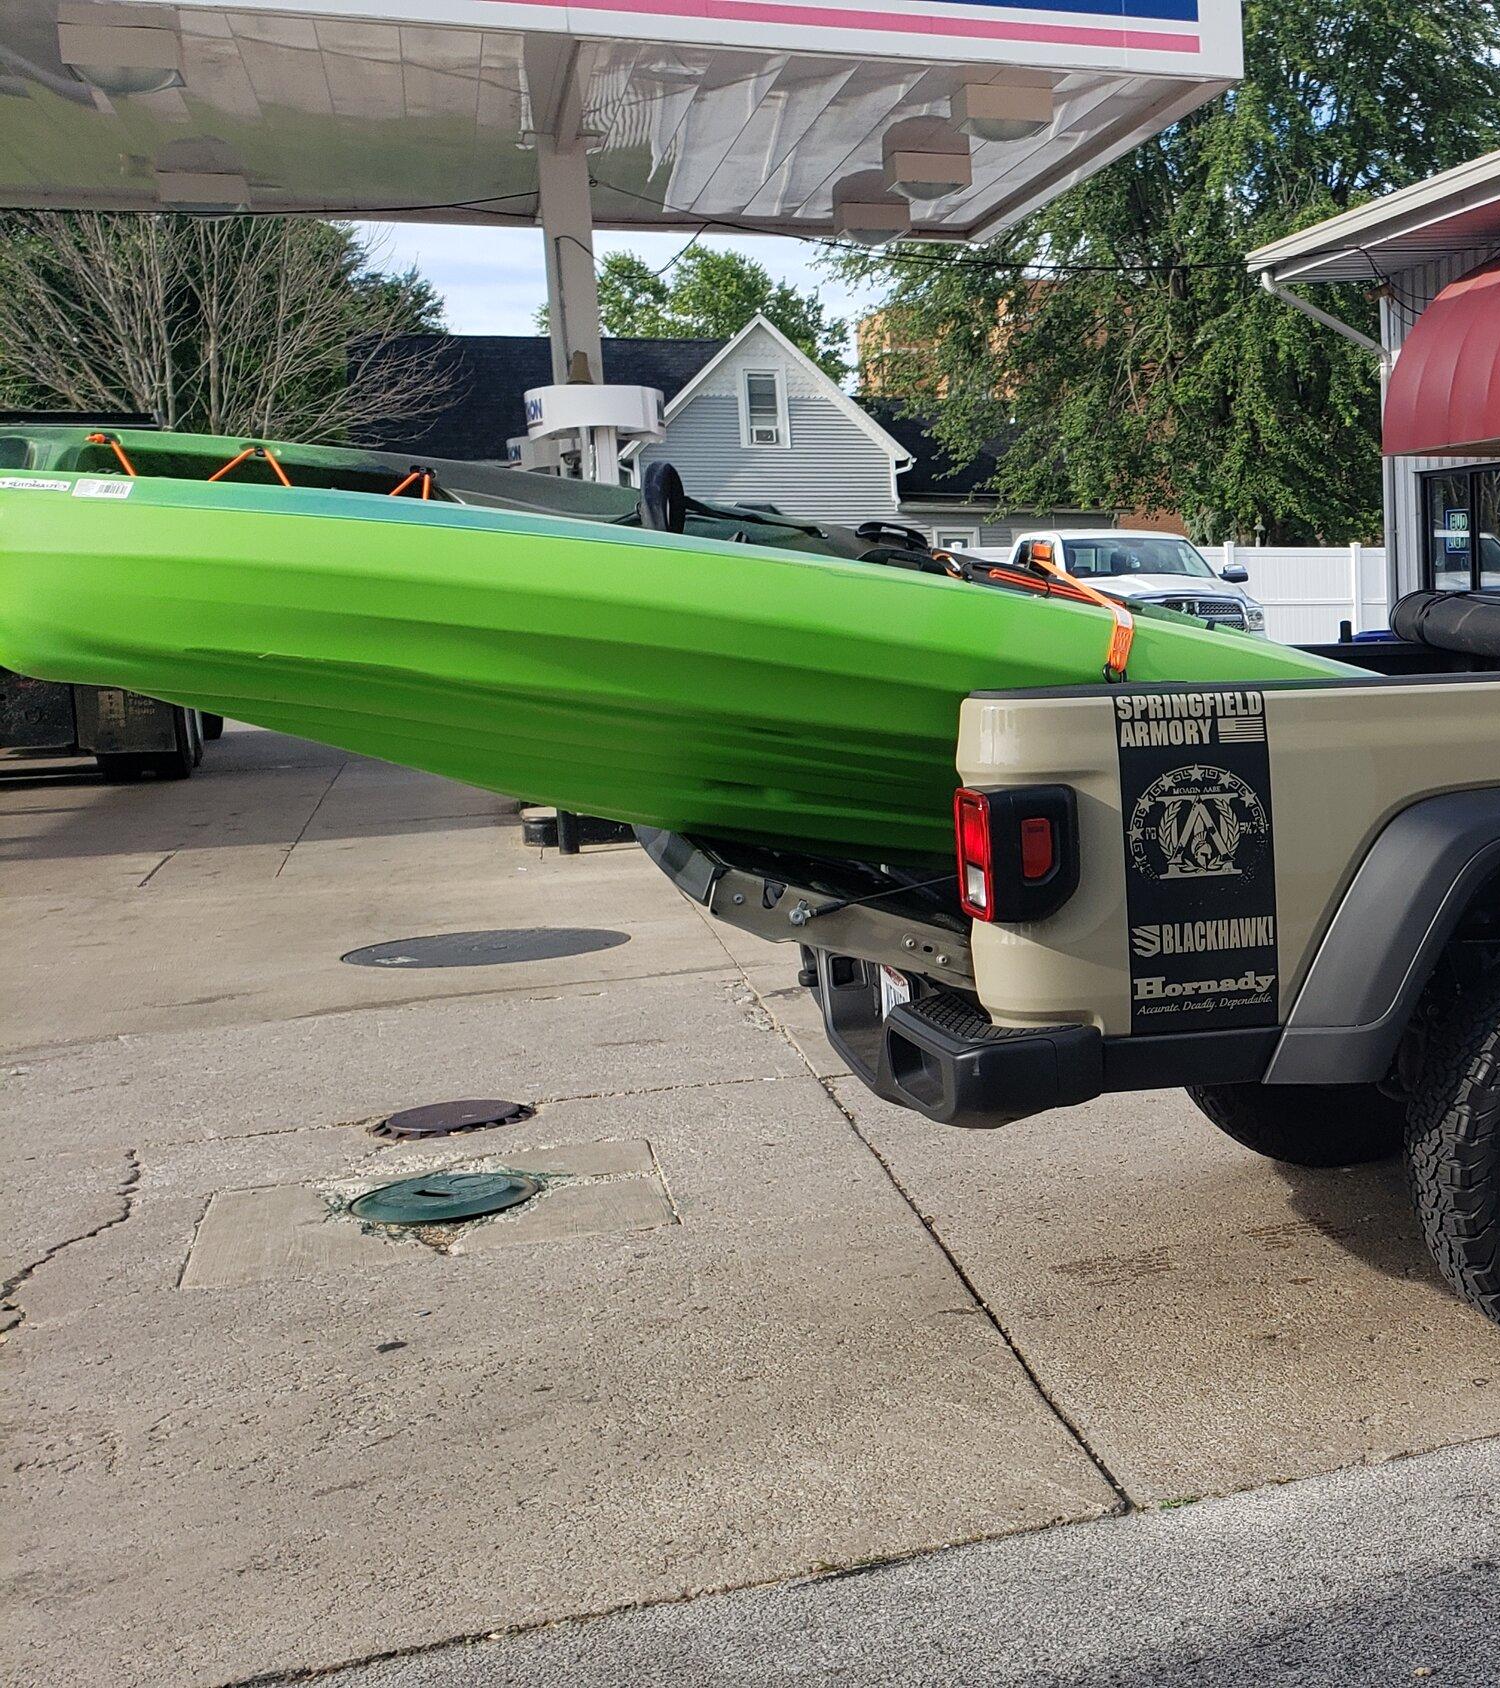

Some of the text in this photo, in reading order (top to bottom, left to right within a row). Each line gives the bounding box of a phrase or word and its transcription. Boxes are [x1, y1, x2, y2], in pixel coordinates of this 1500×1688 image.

[1449, 513, 1468, 531] BUD
[1116, 690, 1264, 720] SPRINGFIELD
[1119, 718, 1213, 747] ARMORY
[1162, 915, 1275, 954] BLACKHAWK!
[1133, 970, 1275, 1001] Hornady
[1219, 992, 1273, 1010] Dependable.
